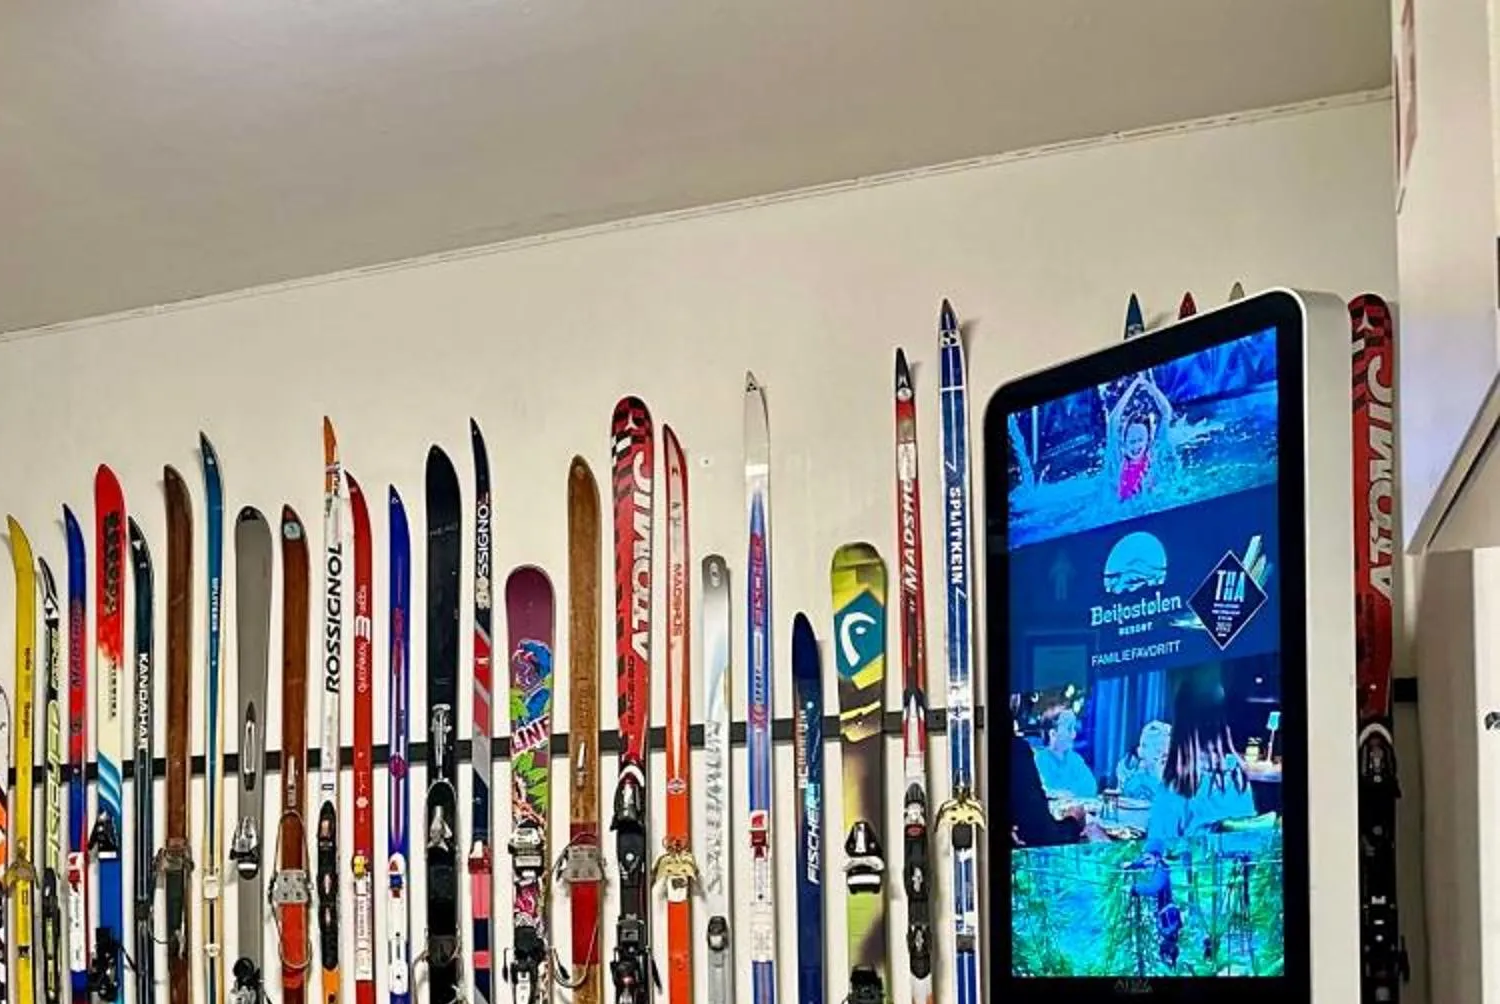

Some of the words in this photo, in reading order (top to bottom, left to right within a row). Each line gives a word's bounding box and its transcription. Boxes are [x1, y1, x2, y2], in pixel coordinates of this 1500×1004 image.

[1368, 355, 1393, 602] ATOMIC
[631, 450, 653, 664] ATOMIC
[949, 487, 963, 585] SPLITKEIN
[325, 543, 341, 695] ROSSIGNOL
[673, 563, 683, 637] MADSHUS
[1090, 591, 1182, 627] Beitostølen
[1118, 622, 1153, 637] RESORT
[138, 652, 150, 750] KANDAHAR
[1091, 640, 1181, 667] FAMILIEFAVORITT
[804, 782, 820, 884] FISCHER
